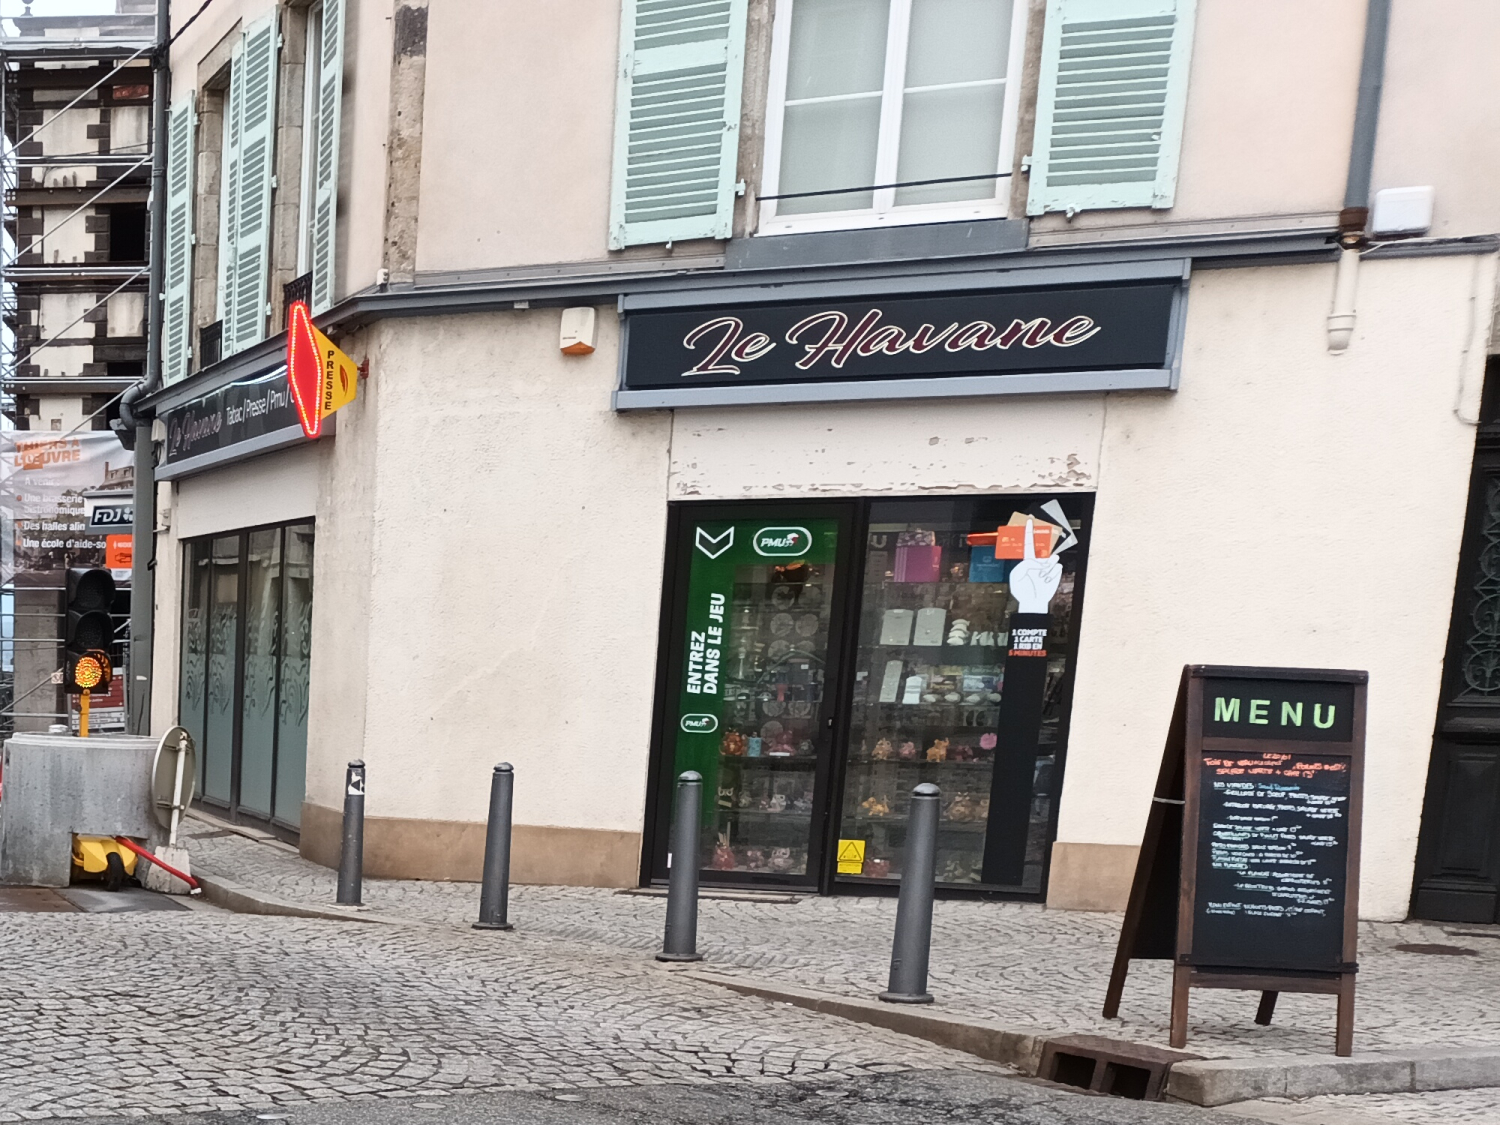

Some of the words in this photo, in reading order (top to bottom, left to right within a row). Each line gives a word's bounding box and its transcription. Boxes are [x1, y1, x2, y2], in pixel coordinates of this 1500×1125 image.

[681, 316, 776, 376] Le
[785, 308, 1101, 369] Havane
[324, 350, 335, 410] PRESSE
[24, 493, 41, 503] Une
[42, 493, 83, 503] brasserie
[23, 521, 40, 531] Des
[42, 521, 67, 531] halles
[94, 508, 121, 523] FDJ
[22, 538, 39, 549] Une
[41, 538, 64, 549] école
[760, 537, 787, 547] PMU
[709, 593, 725, 623] JEU
[707, 626, 722, 645] LE
[686, 631, 706, 694] ENTREZ
[703, 648, 720, 694] DANS
[1213, 697, 1336, 728] MENU
